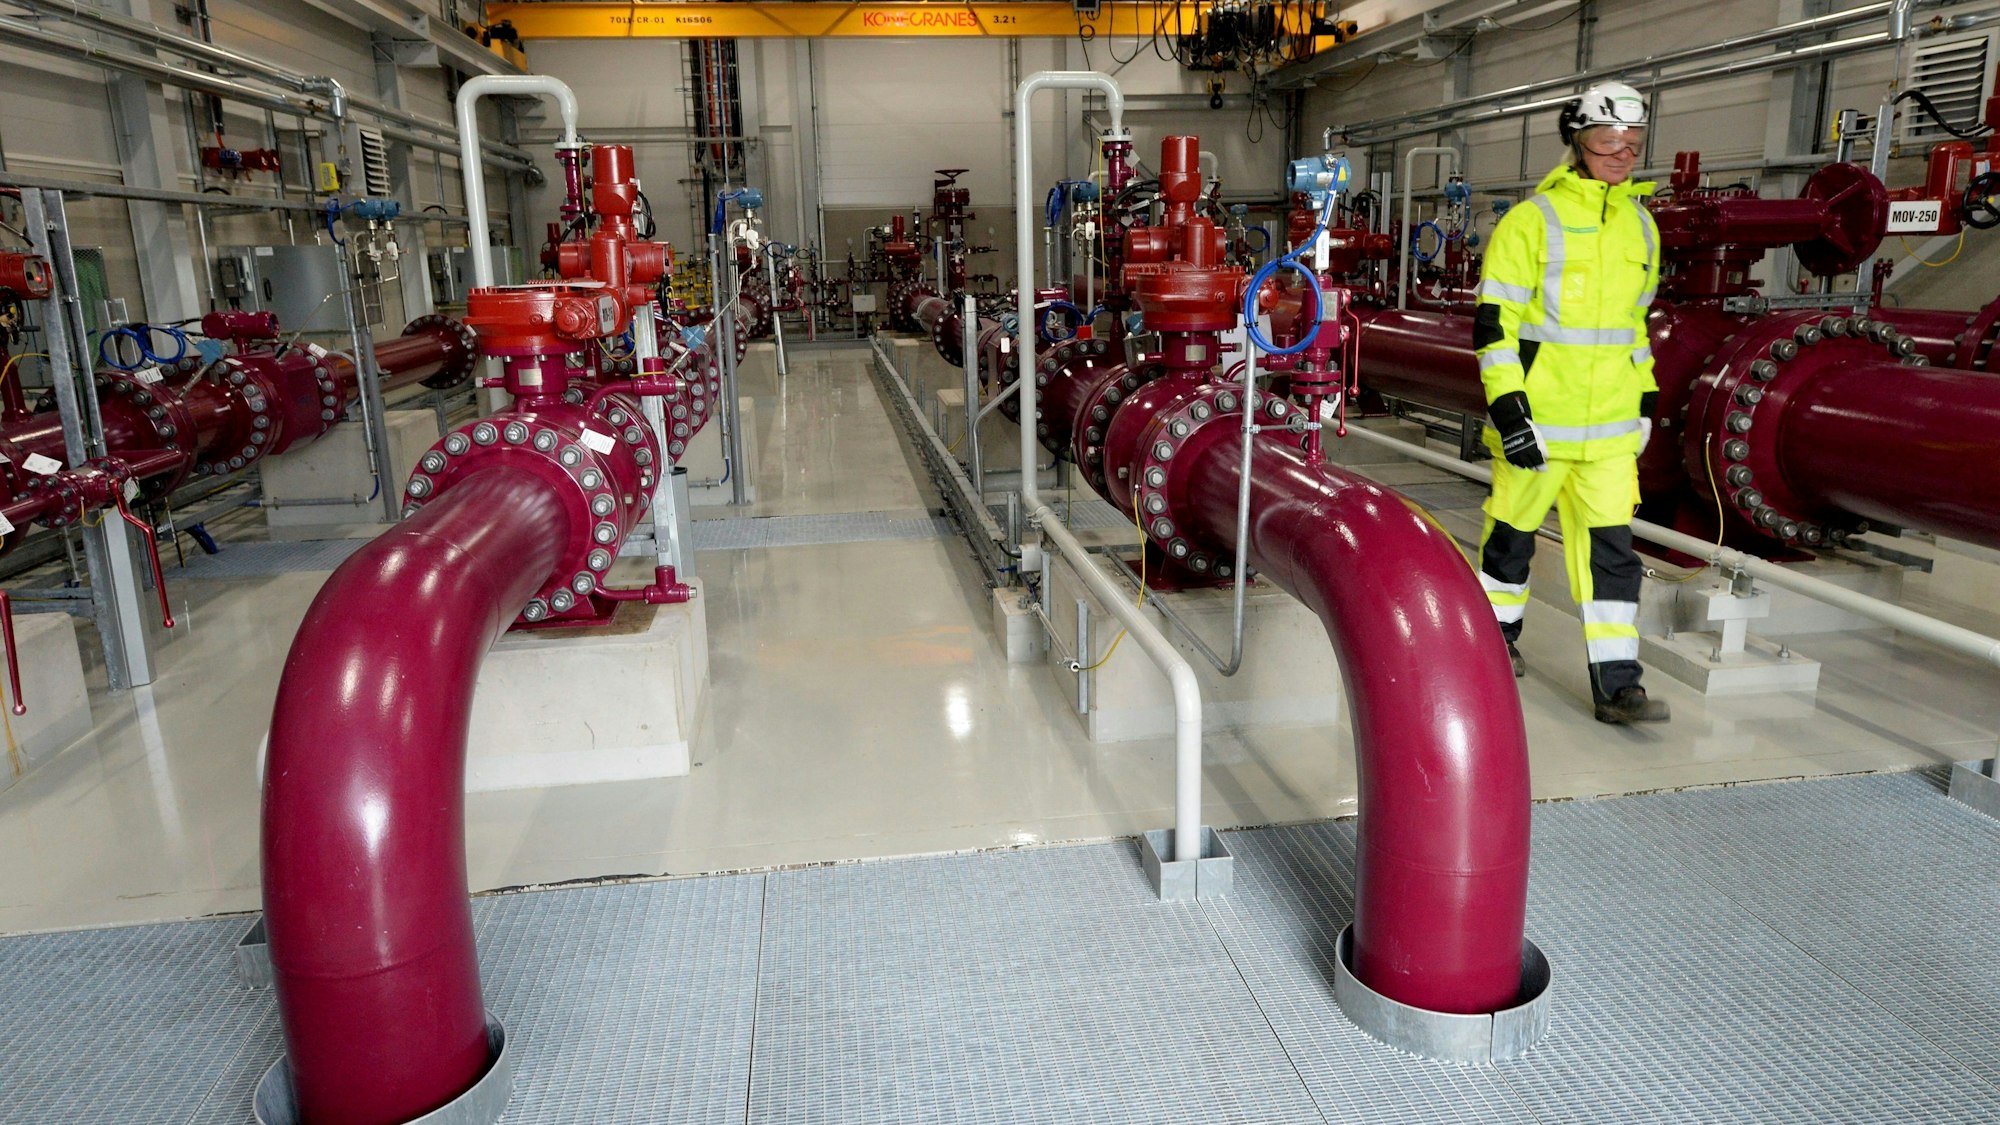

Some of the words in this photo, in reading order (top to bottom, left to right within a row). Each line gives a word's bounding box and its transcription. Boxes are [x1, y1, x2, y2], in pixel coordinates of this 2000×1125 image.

[863, 12, 979, 27] KONECRANES
[992, 15, 1009, 24] 3.2
[1892, 210, 1938, 223] MOV-250
